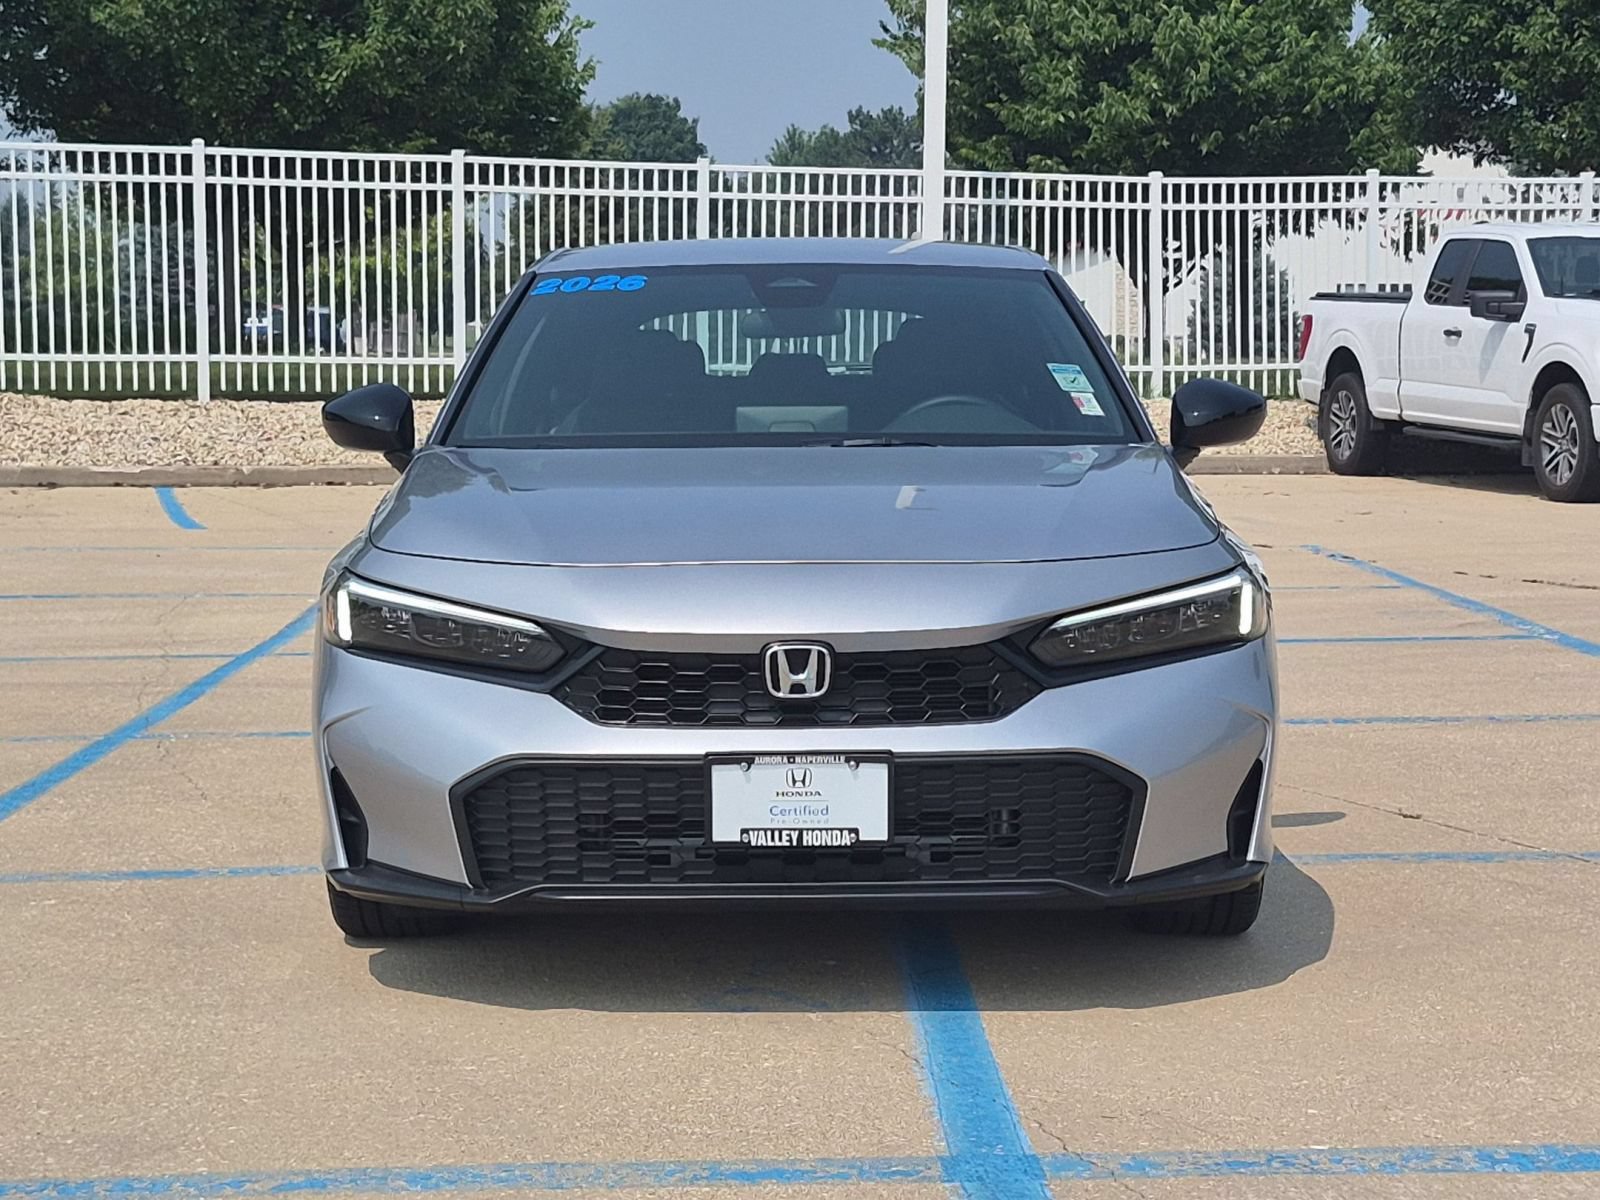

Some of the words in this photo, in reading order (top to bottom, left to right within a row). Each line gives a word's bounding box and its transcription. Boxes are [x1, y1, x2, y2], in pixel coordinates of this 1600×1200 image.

[530, 274, 648, 296] 2026
[754, 756, 788, 765] AURORA
[795, 755, 846, 764] NAPERVILLE
[769, 805, 829, 817] Certified
[749, 830, 799, 846] VALLEY
[802, 830, 850, 846] HONDA
